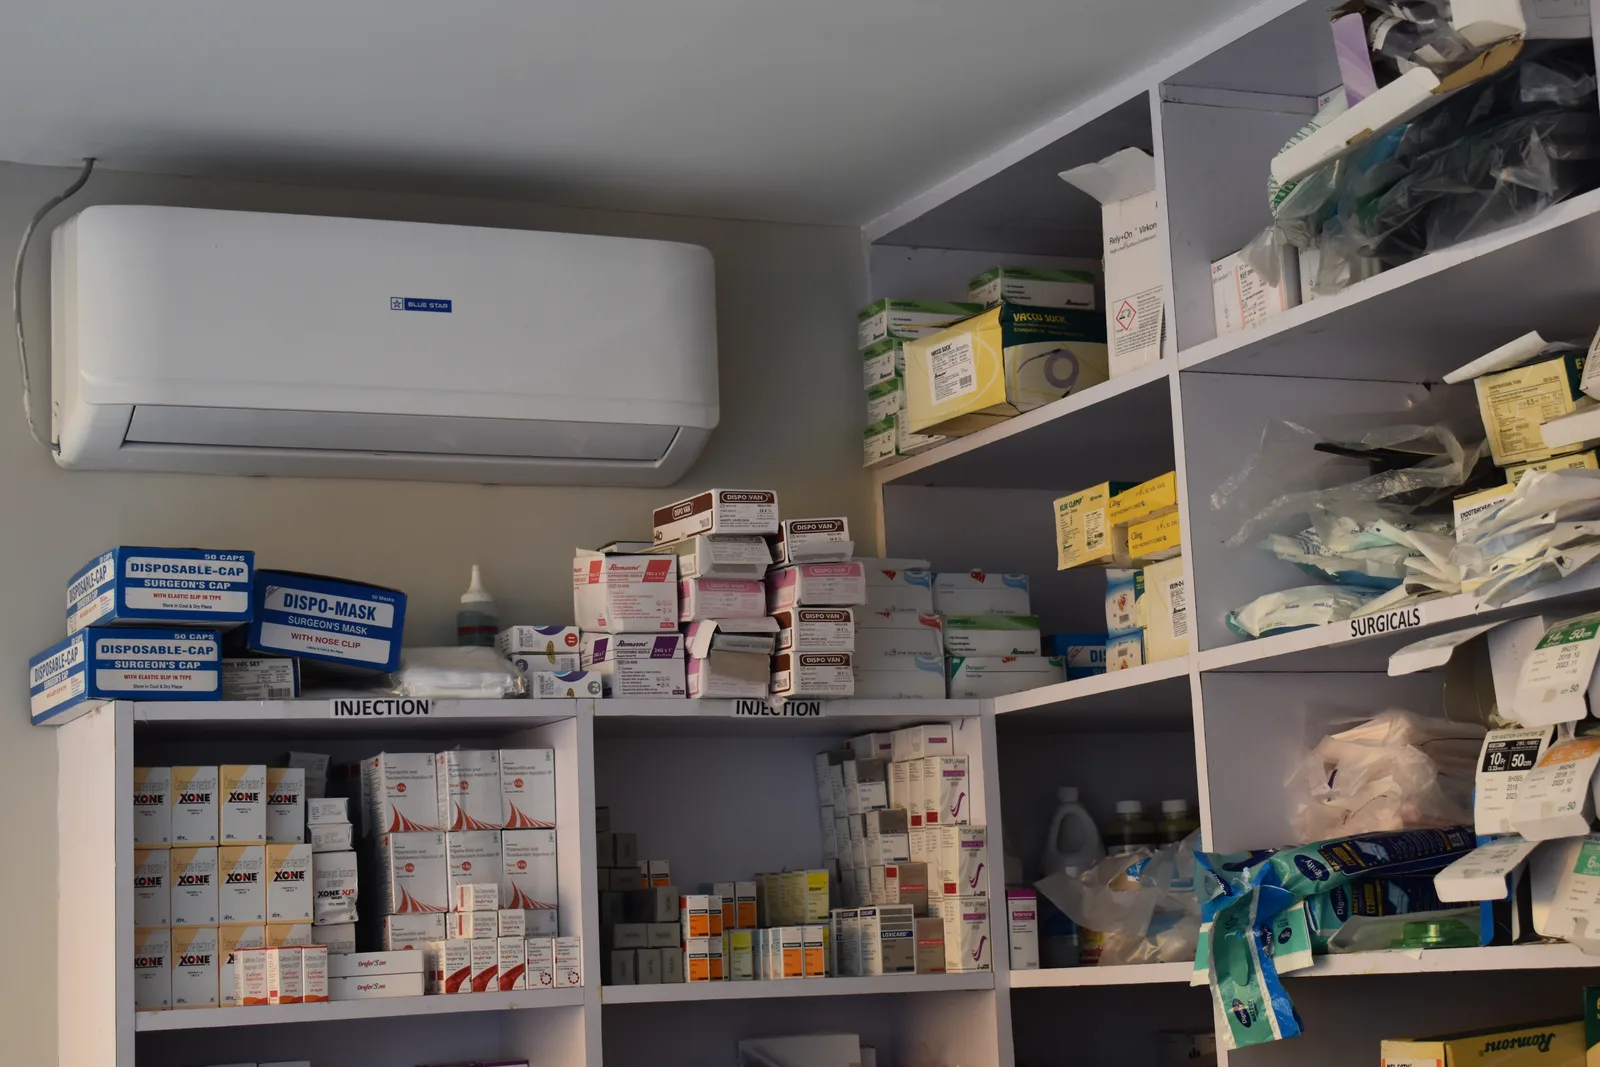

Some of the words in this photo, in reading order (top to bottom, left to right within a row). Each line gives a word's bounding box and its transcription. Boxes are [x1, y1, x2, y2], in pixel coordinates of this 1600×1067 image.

[1110, 231, 1132, 245] Rely+On
[1138, 222, 1158, 234] Virkon
[1013, 312, 1043, 322] VACCU
[130, 562, 244, 577] DISPOSABLE-CAP
[69, 565, 107, 604] DISPOSABLE-CAP
[144, 579, 206, 589] SURGEON'S
[208, 582, 231, 590] CAP
[283, 592, 377, 622] DISPO-MASK
[288, 615, 340, 630] SURGEON'S
[342, 624, 368, 635] MASK
[1350, 608, 1420, 637] SURGICALS
[1569, 628, 1592, 640] 50cm
[291, 633, 313, 641] WITH
[315, 636, 339, 645] NOSE
[341, 640, 361, 649] CLIP
[101, 645, 214, 655] DISPOSABLE-CAP
[34, 646, 79, 682] DISPOSABLE-CAP
[114, 660, 176, 668] SURGEON'S
[1570, 684, 1579, 692] 50
[334, 700, 428, 716] INJECTION
[1511, 754, 1532, 767] 50cm
[179, 792, 211, 804] XONE
[228, 790, 260, 803] XONE
[268, 793, 298, 805] XONE
[1567, 801, 1576, 810] 50
[177, 873, 210, 886] XONE
[226, 871, 257, 884] XONE
[274, 870, 305, 882] XONE
[317, 890, 340, 898] XONE
[179, 954, 210, 966] XONE
[1484, 1033, 1555, 1053] Romsons
